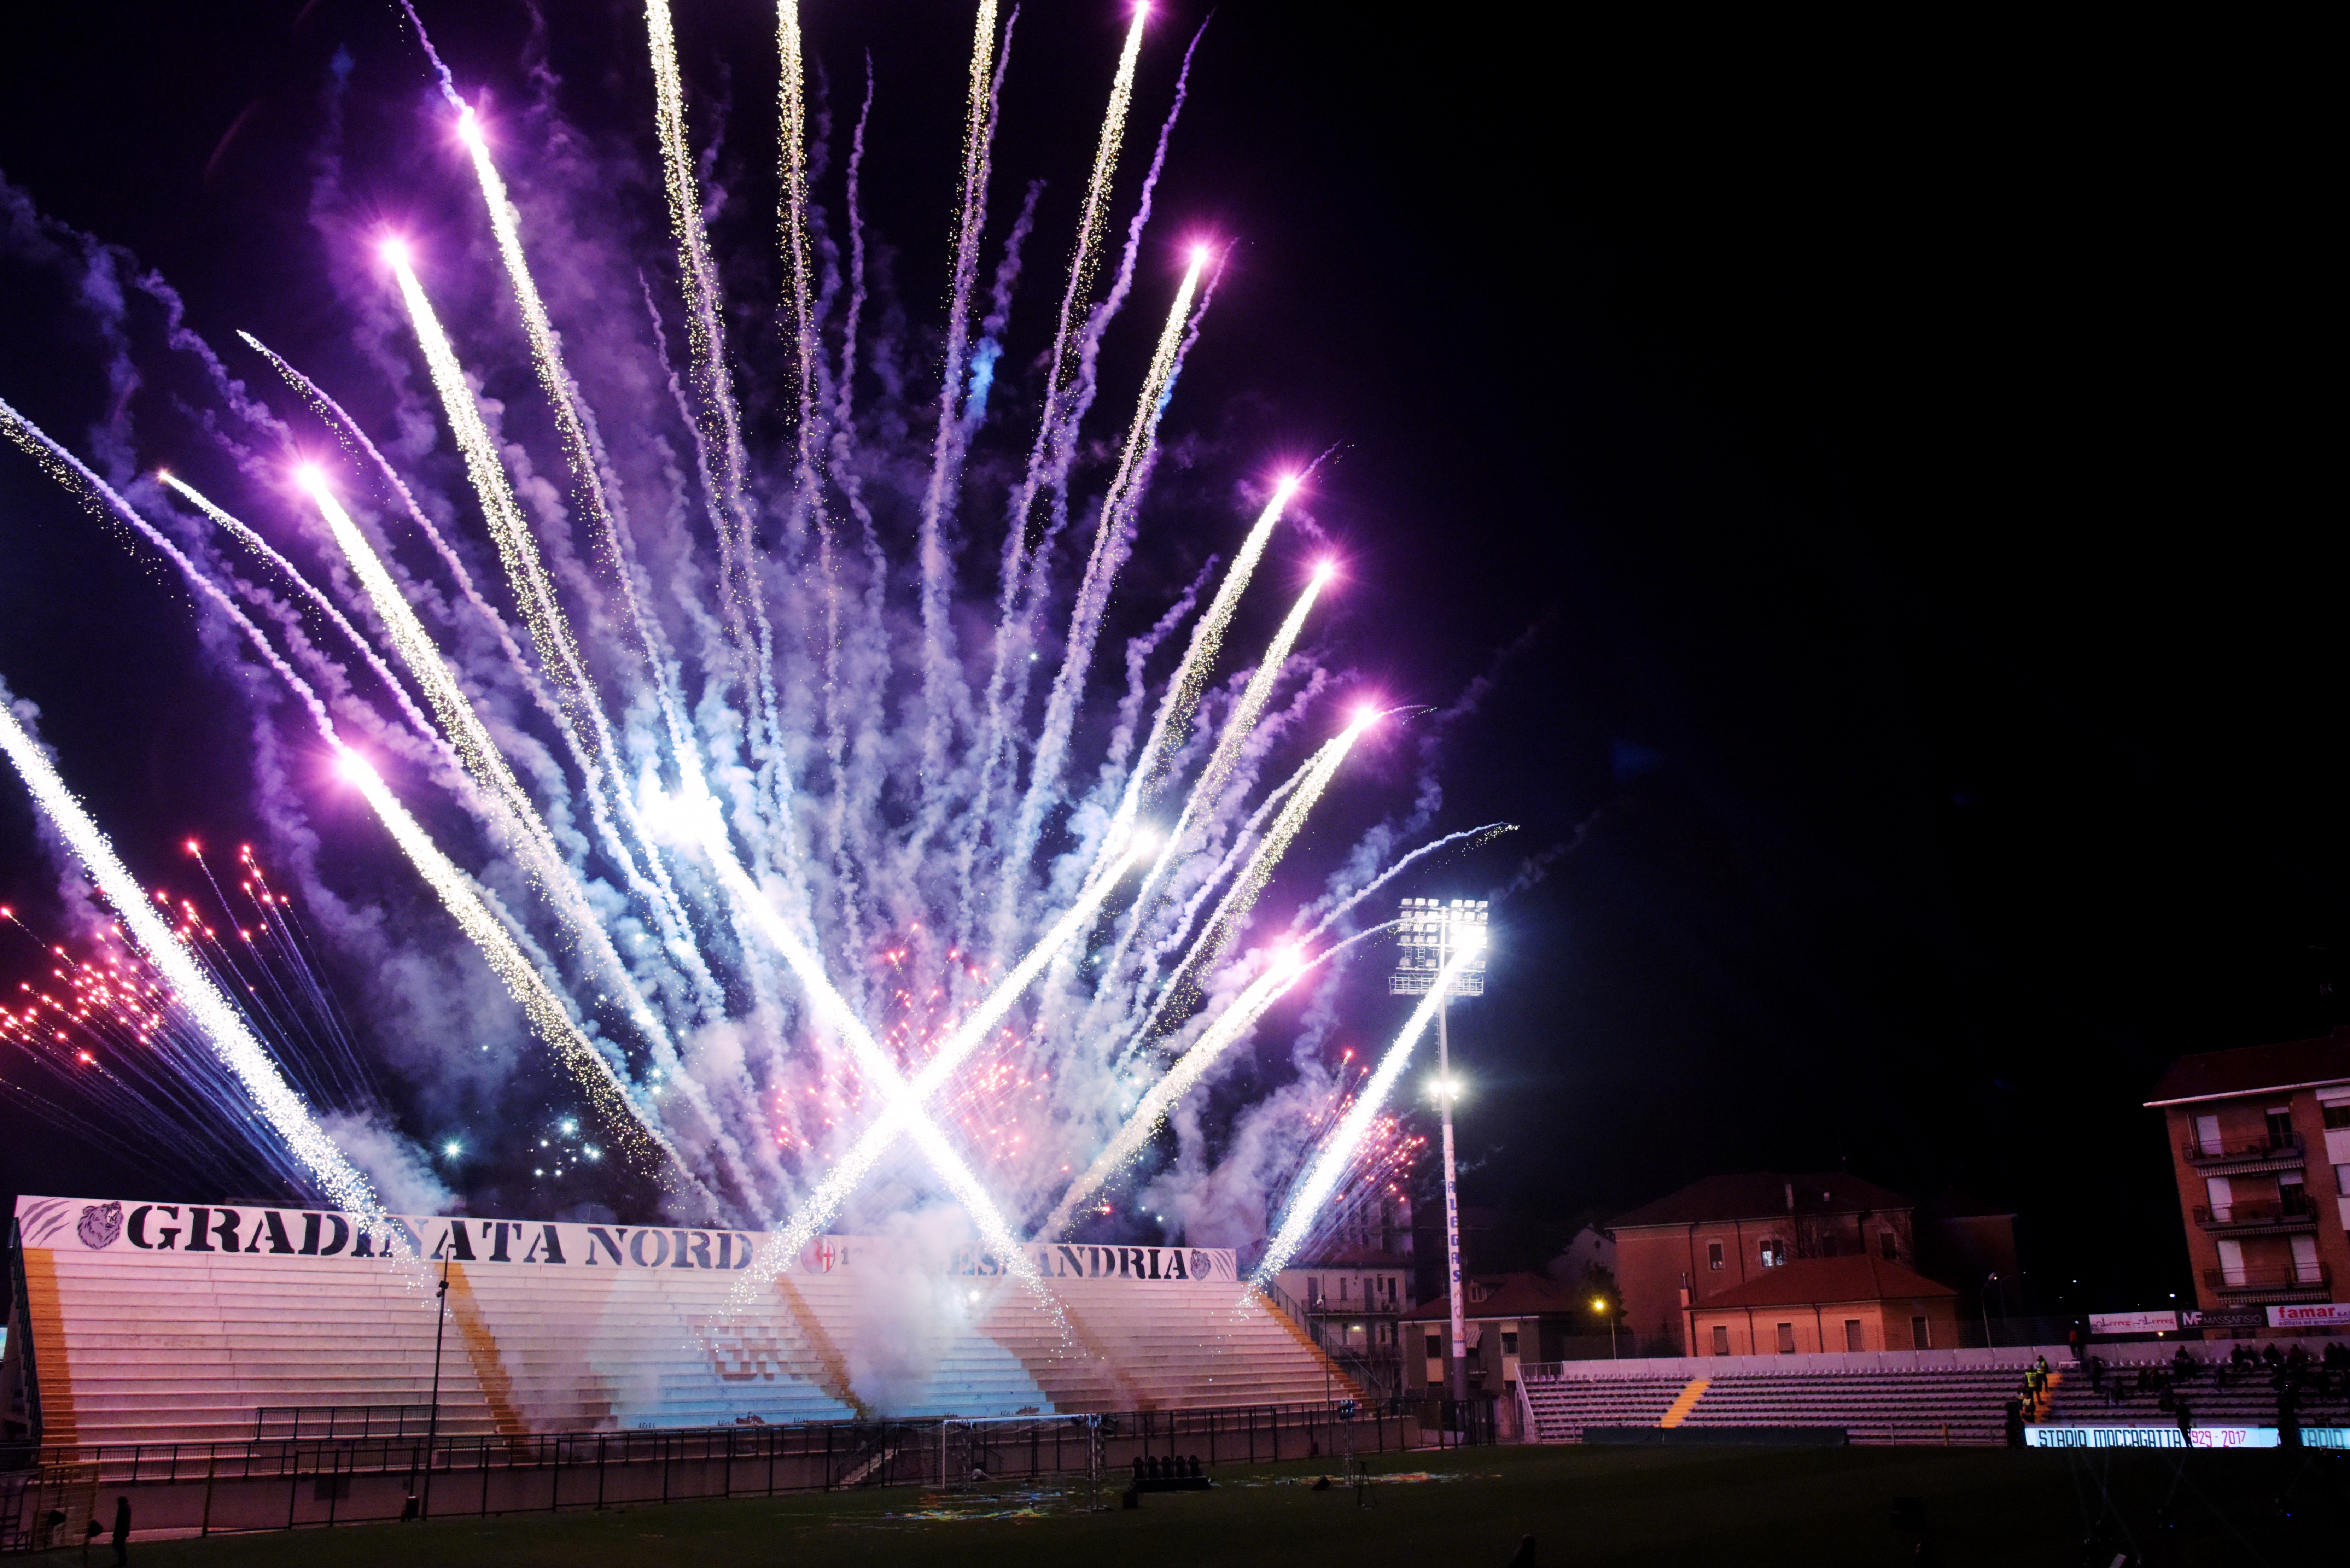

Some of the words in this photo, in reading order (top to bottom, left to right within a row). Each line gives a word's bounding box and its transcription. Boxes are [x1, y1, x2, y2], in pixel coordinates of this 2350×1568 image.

[127, 1205, 566, 1264] GRADINATA
[585, 1227, 753, 1269] NORD
[1447, 1180, 1461, 1282] ALEGAS
[2182, 1311, 2203, 1326] MF
[2278, 1306, 2335, 1318] famar
[2038, 1429, 2088, 1447] STADIO
[2093, 1429, 2182, 1447] MOCCAGATTA
[2188, 1430, 2212, 1447] 929
[2221, 1430, 2246, 1447] 2017
